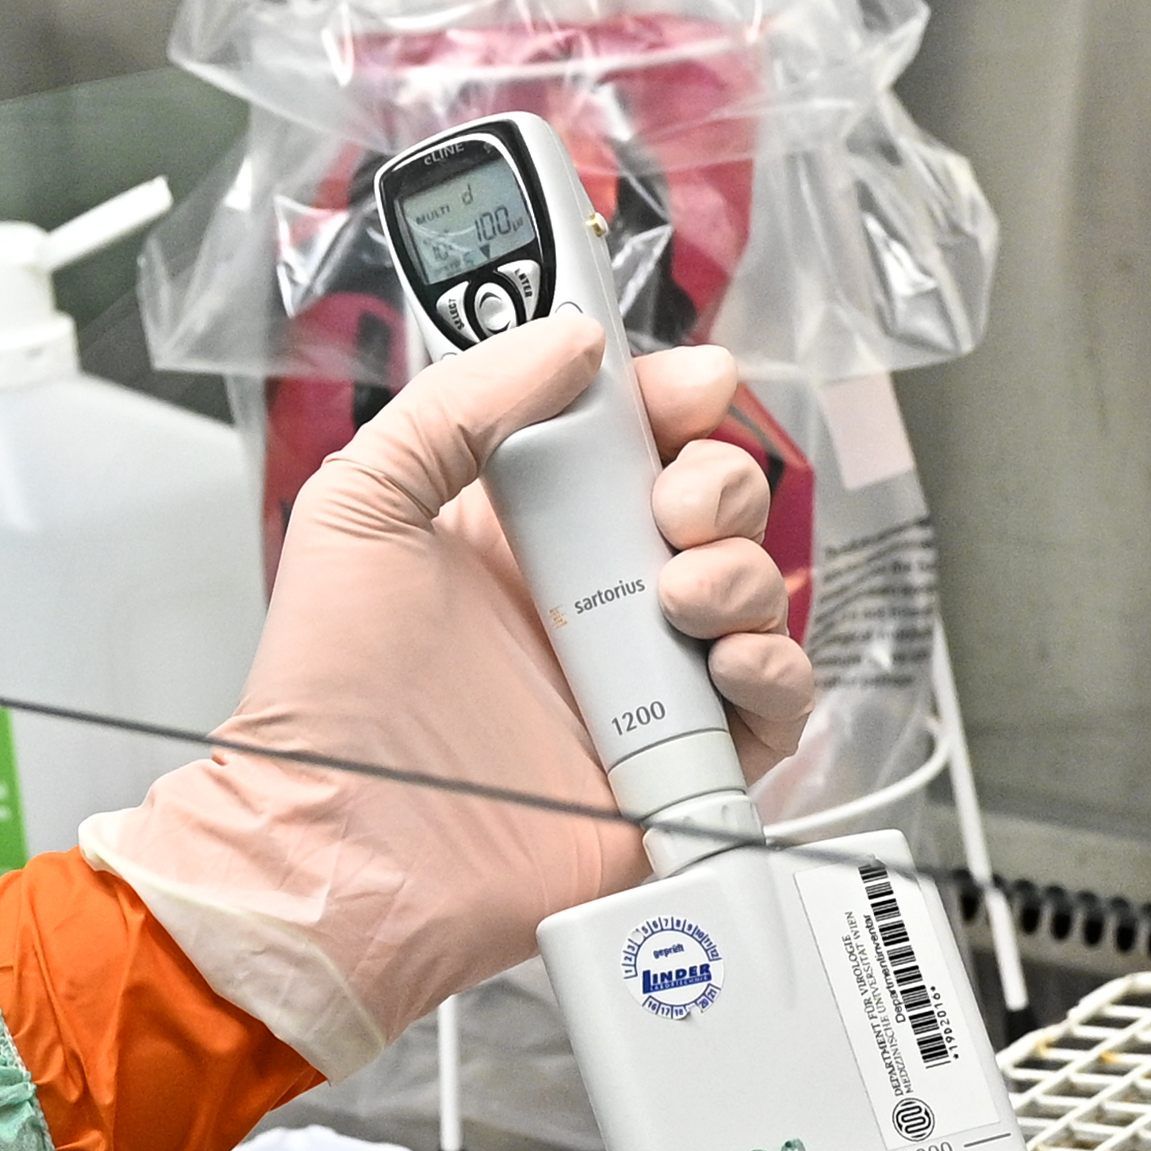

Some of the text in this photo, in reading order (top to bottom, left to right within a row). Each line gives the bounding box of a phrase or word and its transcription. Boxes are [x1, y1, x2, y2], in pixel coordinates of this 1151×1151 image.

[416, 205, 450, 225] MULTI
[475, 206, 512, 242] 100
[574, 578, 646, 615] sartorius
[611, 700, 666, 736] 1200
[863, 913, 907, 1024] Departmentinventar
[841, 933, 904, 1097] DEPARTMENT FÜR VIROLOGIE
[879, 1018, 914, 1095] MEDIZINISCHE
